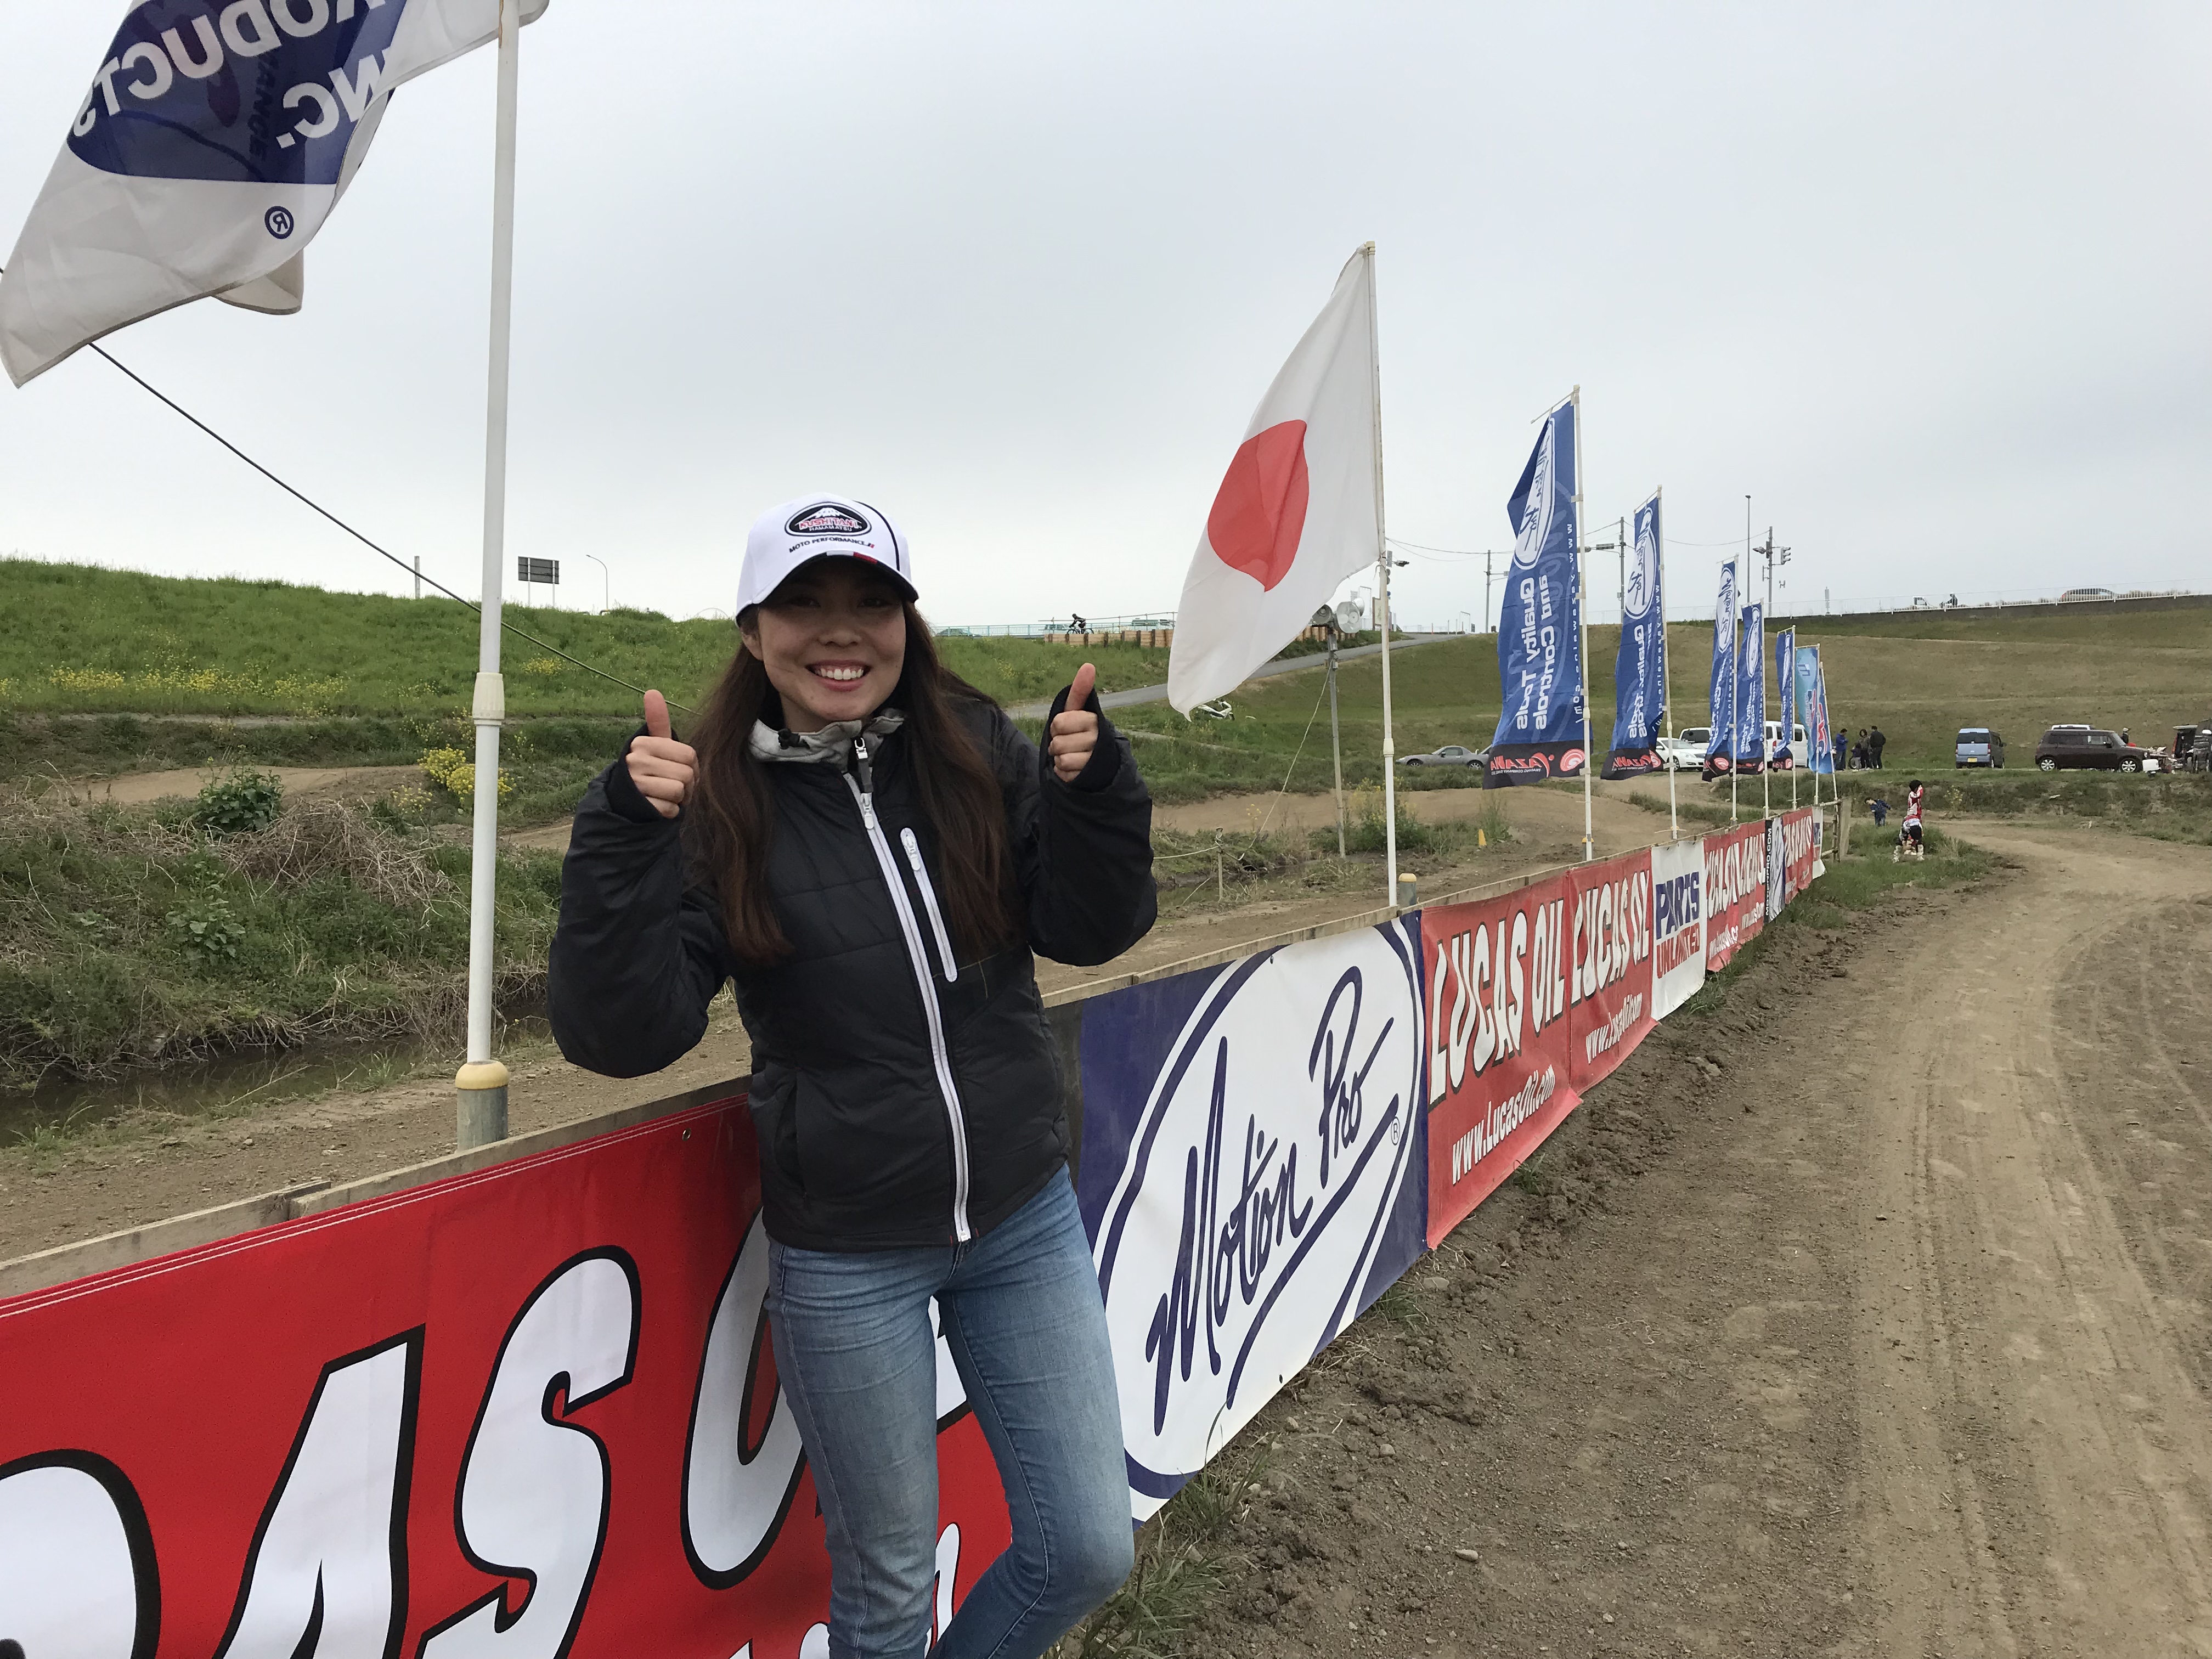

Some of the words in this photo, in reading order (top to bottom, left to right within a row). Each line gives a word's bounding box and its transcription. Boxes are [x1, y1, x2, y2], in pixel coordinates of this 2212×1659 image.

[788, 540, 810, 553] MOTO
[1570, 878, 1629, 1008] LUCAS
[1655, 871, 1700, 940] PARTS
[1656, 922, 1701, 980] UNLIMTED
[1427, 909, 1527, 1113] LUCAS
[1531, 898, 1565, 1037] OIL
[1452, 1064, 1556, 1186] www.LucasOil.com
[1145, 1036, 1314, 1436] Motion
[1309, 966, 1395, 1189] Pro
